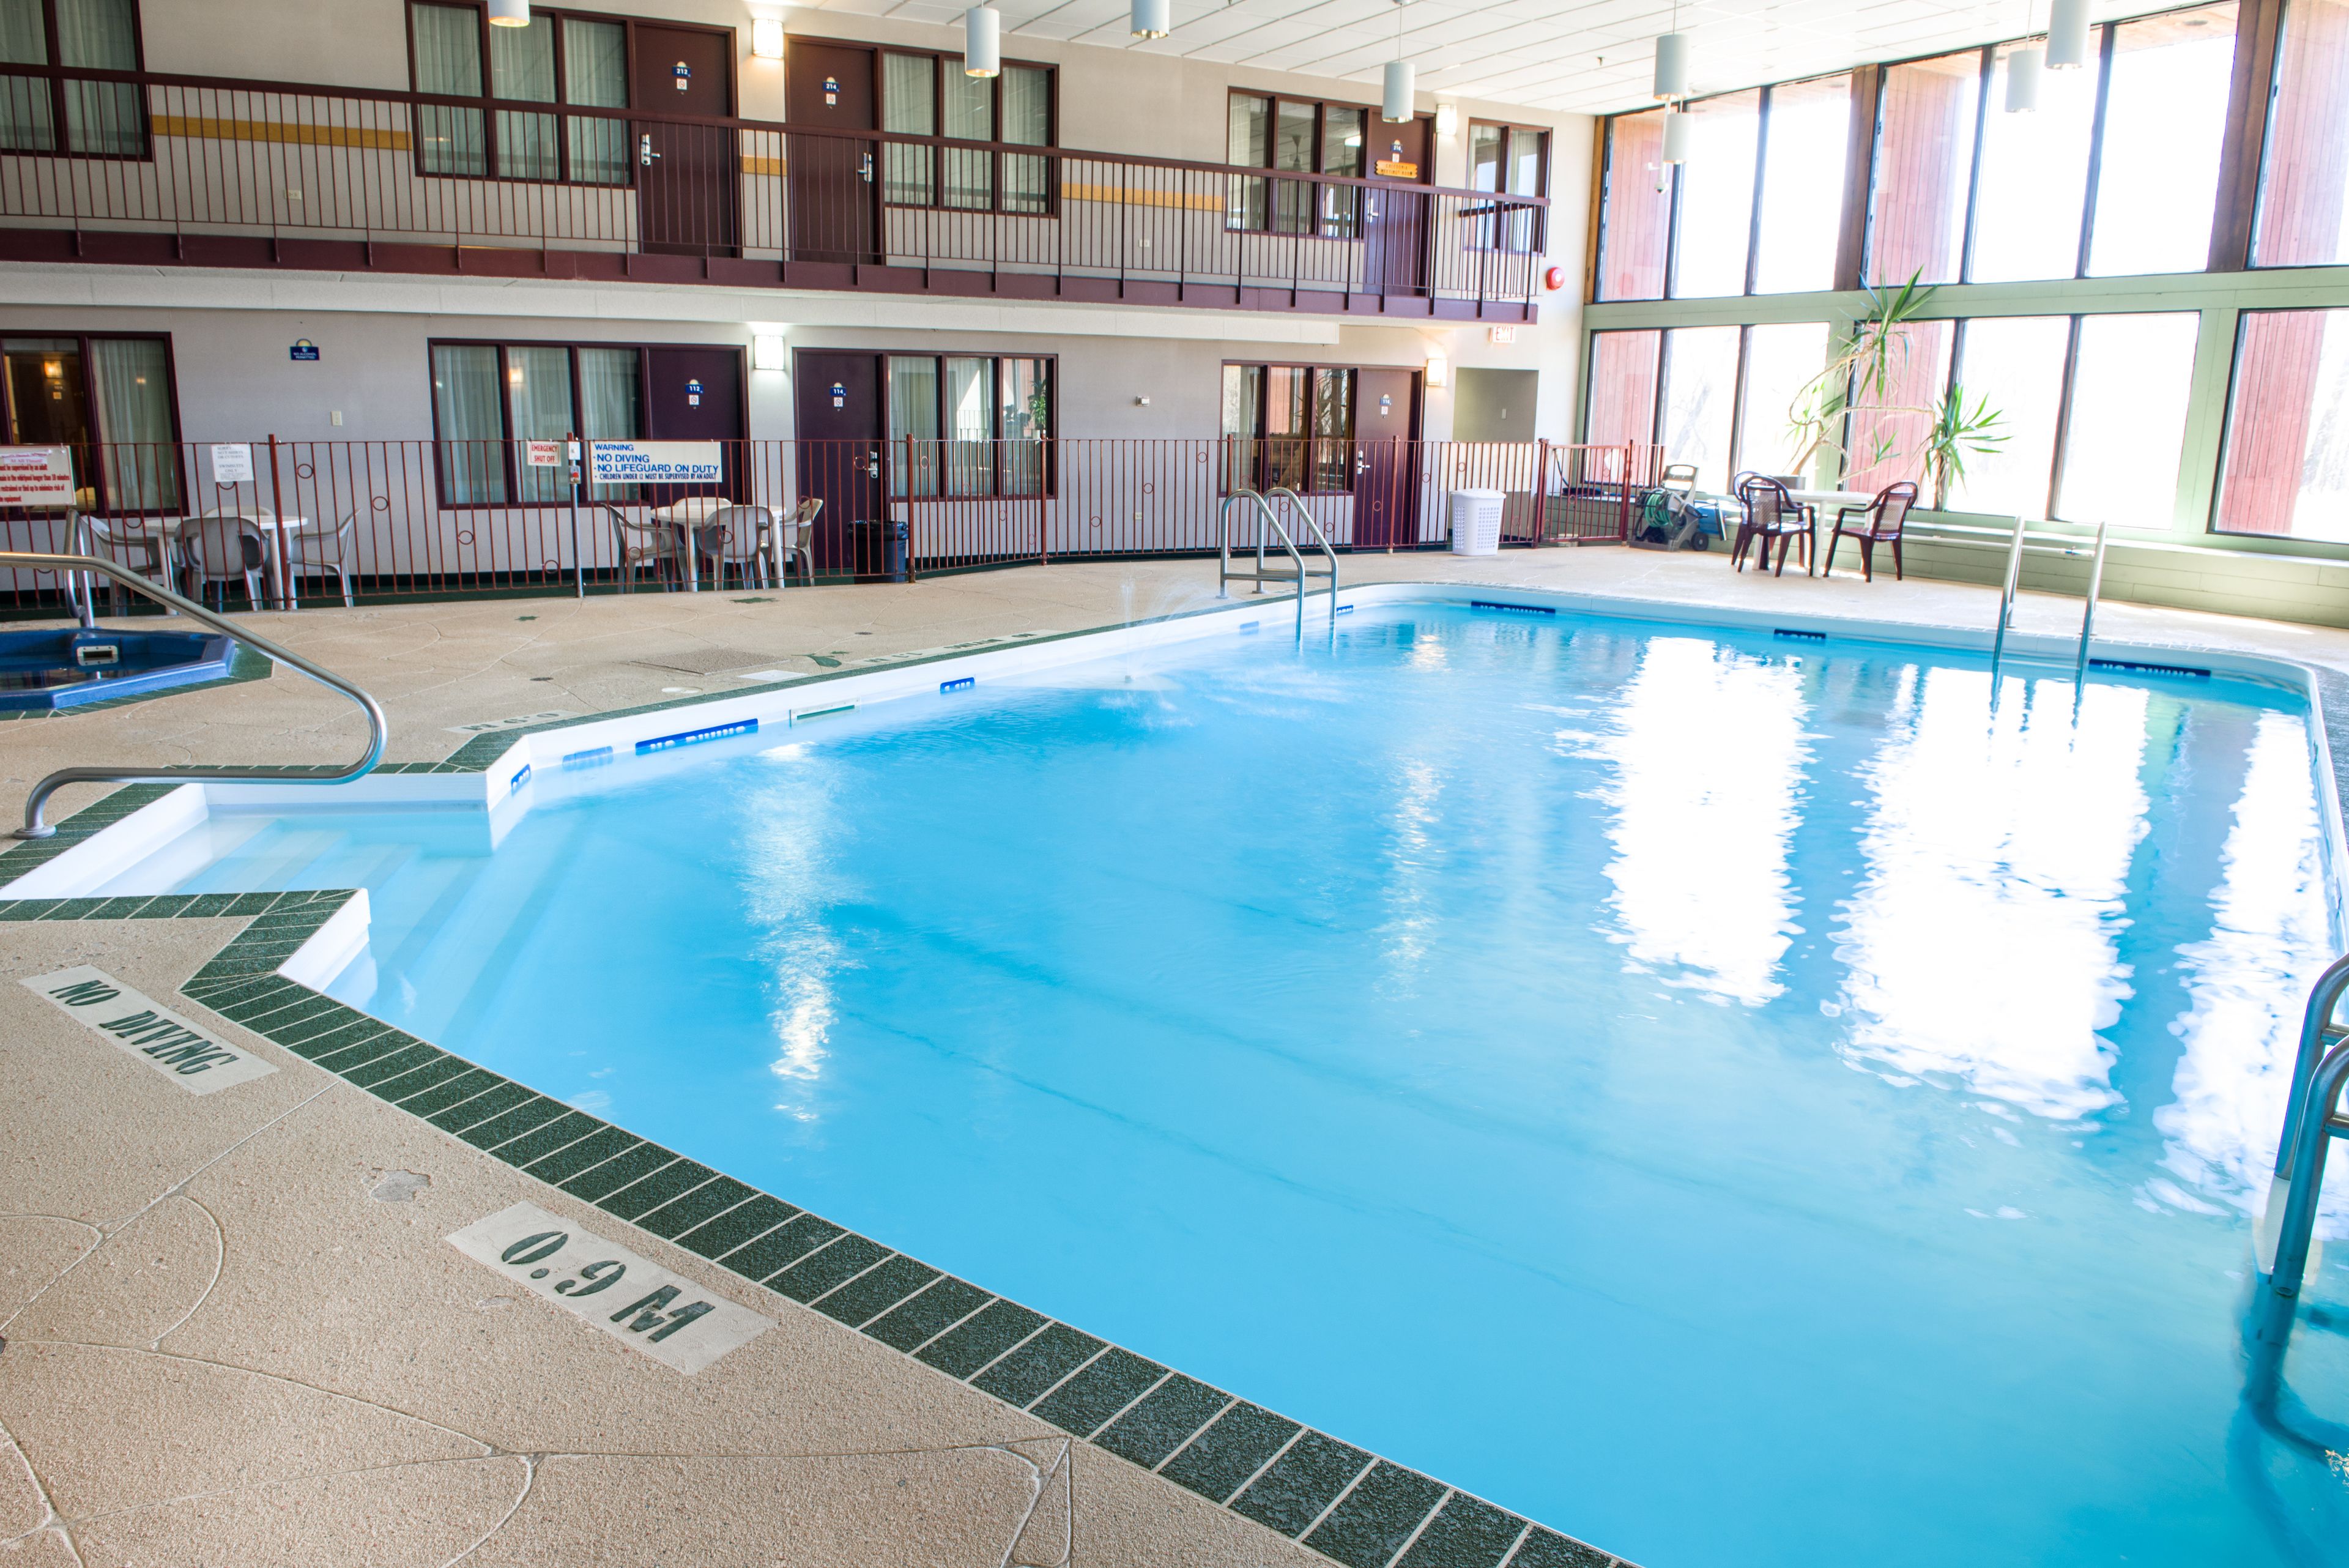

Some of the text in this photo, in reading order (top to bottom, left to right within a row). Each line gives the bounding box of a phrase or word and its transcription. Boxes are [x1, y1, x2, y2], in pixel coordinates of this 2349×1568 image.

[598, 464, 612, 472] NO
[615, 464, 671, 472] LIFEGUARD
[692, 465, 719, 474] DUTY
[615, 454, 650, 463] DIVING
[49, 979, 240, 1074] NO DIVING
[502, 1231, 716, 1343] 0.9 M
